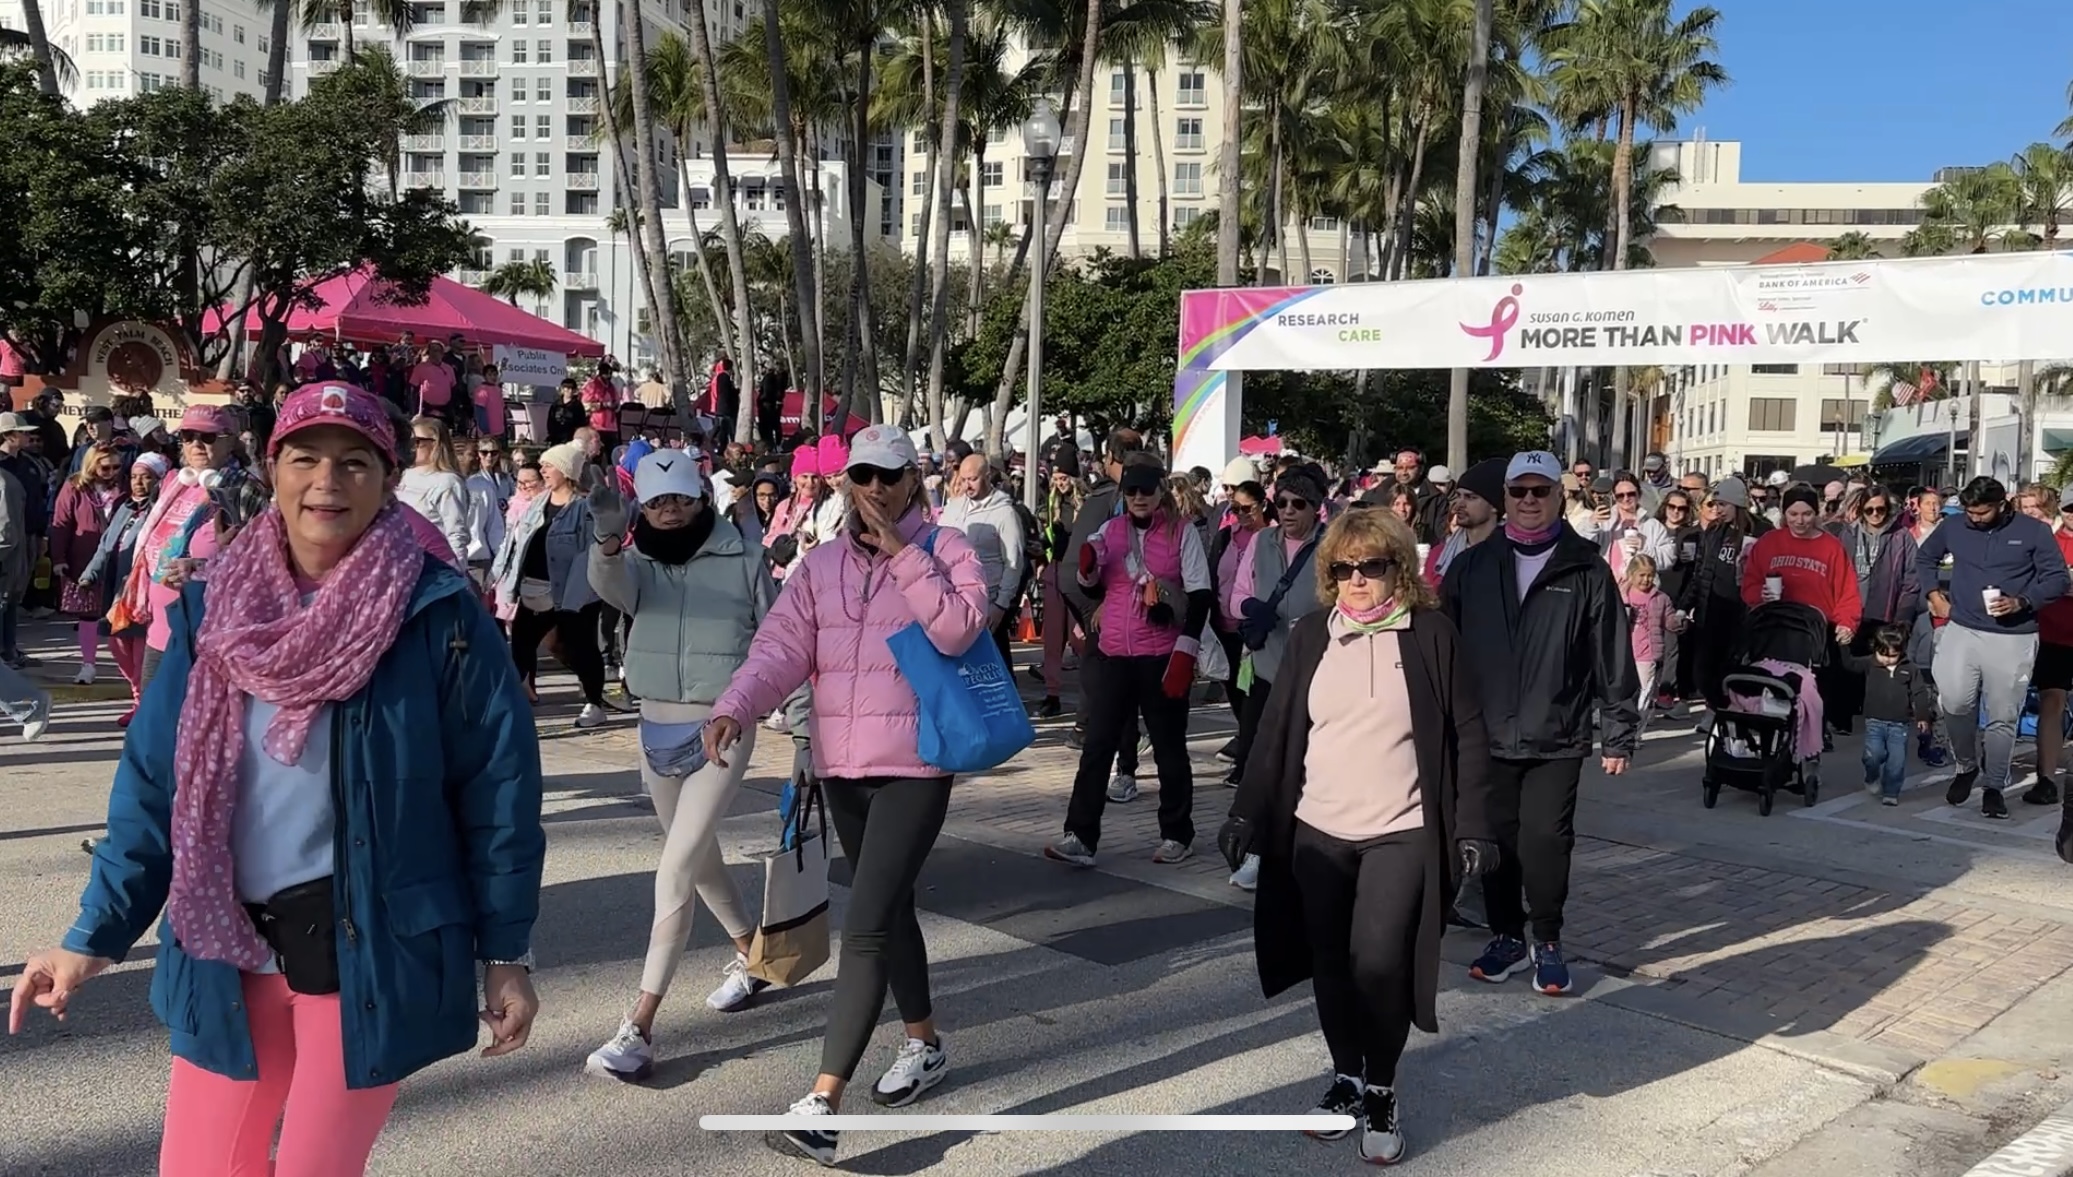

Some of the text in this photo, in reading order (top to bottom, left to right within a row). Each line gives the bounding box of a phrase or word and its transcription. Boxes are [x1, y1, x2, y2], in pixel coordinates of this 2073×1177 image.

[1759, 278, 1848, 288] BANK OF AMERICA
[1278, 313, 1360, 327] RESEARCH
[1338, 329, 1382, 342] CARE
[1521, 327, 1597, 348] MORE
[1603, 325, 1683, 347] THAN
[1690, 323, 1758, 346] PINK
[95, 329, 174, 367] WEST PALM BEACH
[517, 349, 547, 360] Publix
[500, 361, 548, 375] ssociates
[1770, 555, 1827, 577] OHIO STATE
